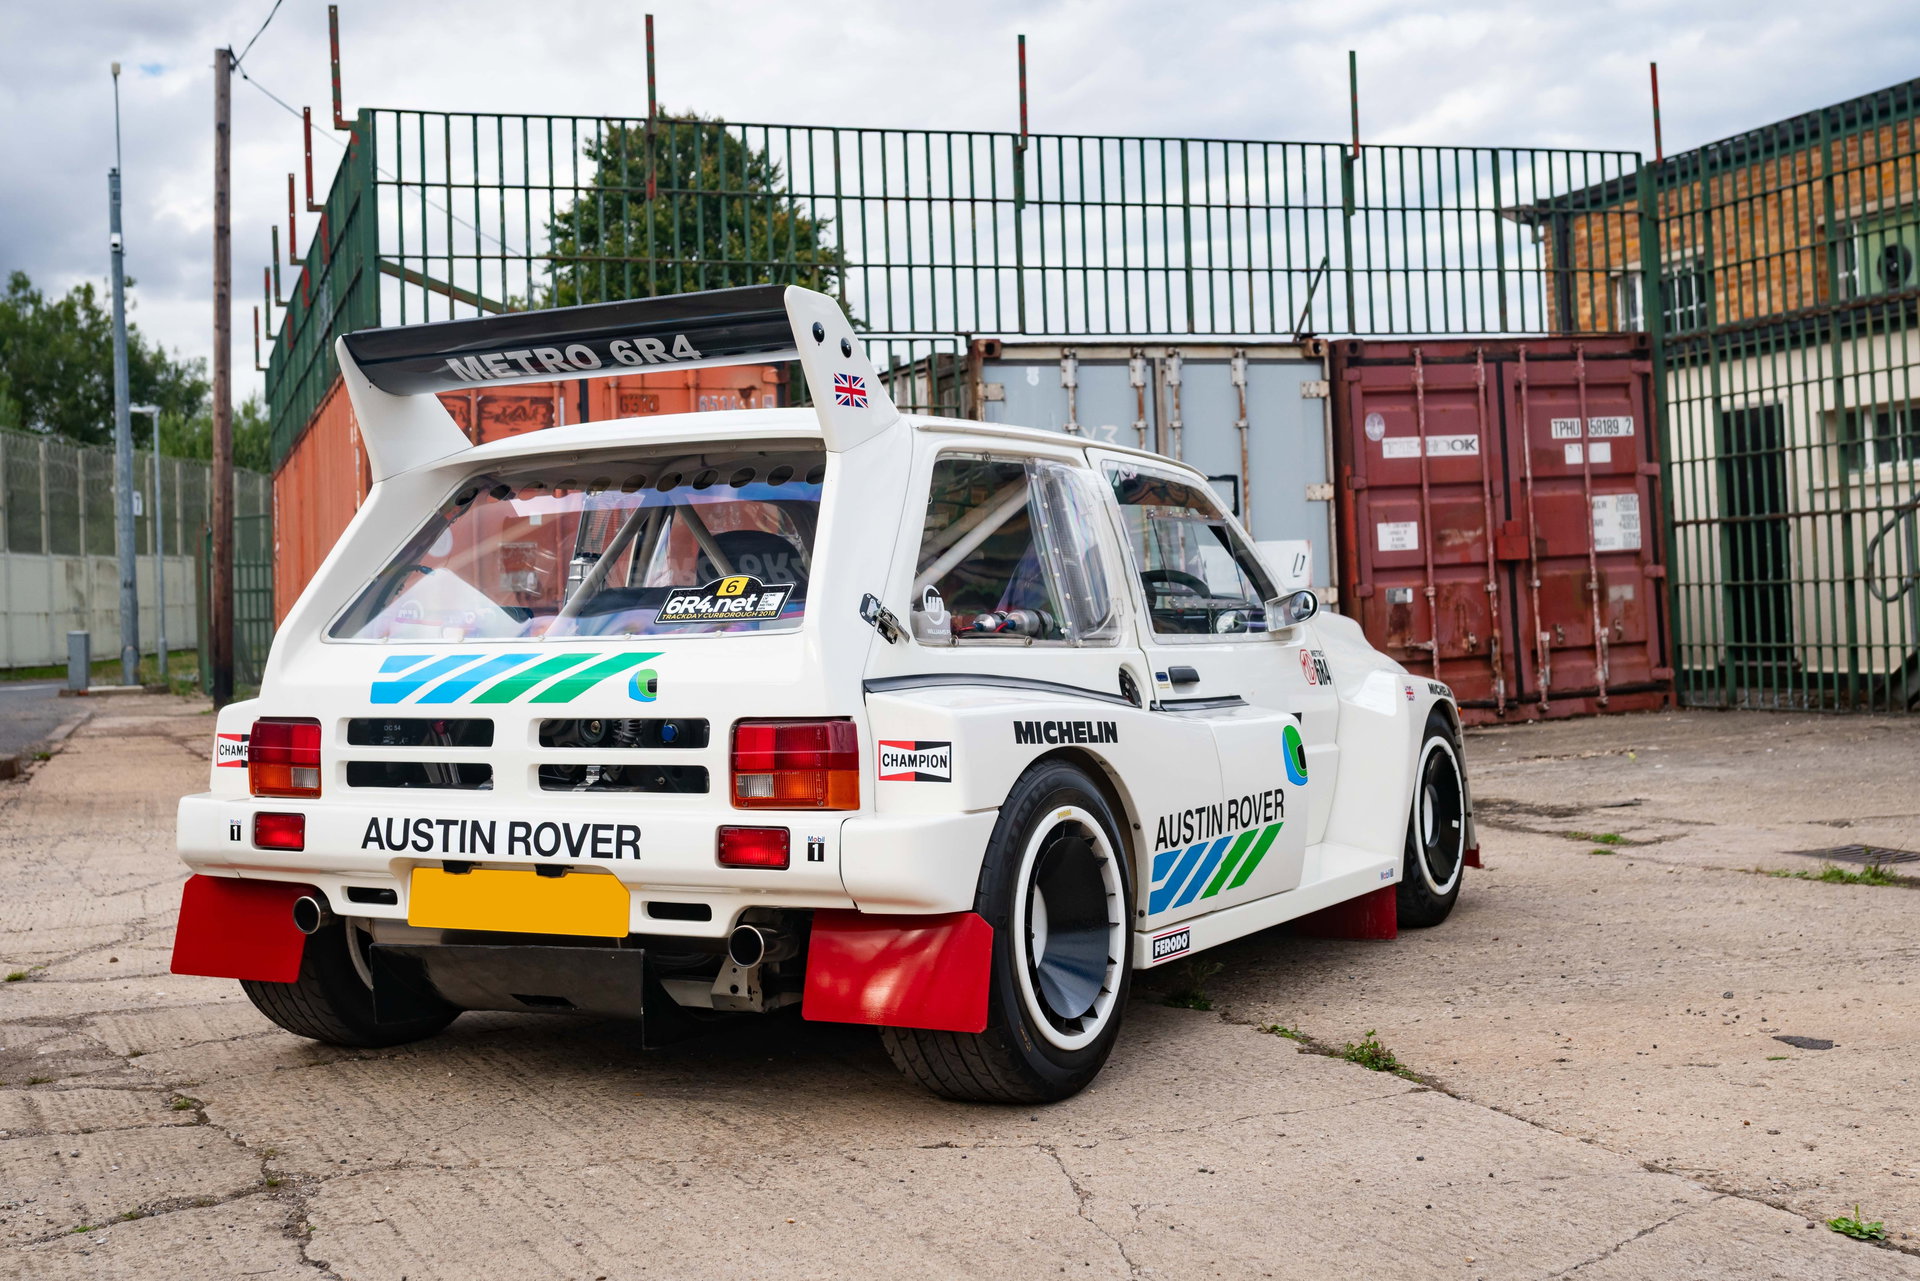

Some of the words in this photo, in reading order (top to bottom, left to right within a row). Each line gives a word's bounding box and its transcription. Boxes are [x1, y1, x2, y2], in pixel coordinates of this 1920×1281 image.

[445, 343, 603, 383] METRO
[609, 334, 703, 366] 6R4
[1553, 420, 1580, 437] TPHU
[1586, 418, 1619, 436] 58189
[725, 580, 740, 594] 6
[665, 593, 759, 615] 6R4.net
[703, 610, 758, 619] CURBOROUGH
[1013, 720, 1119, 745] MICHELIN
[219, 743, 249, 757] CHAMP
[881, 752, 949, 769] CHAMPION
[1154, 802, 1223, 852] AUSTIN
[1227, 788, 1285, 832] ROVER
[232, 825, 239, 840] 1
[360, 816, 497, 855] AUSTIN
[507, 820, 642, 860] ROVER
[807, 835, 825, 843] Mobil
[812, 843, 819, 861] 1
[1154, 933, 1188, 957] FERODO
